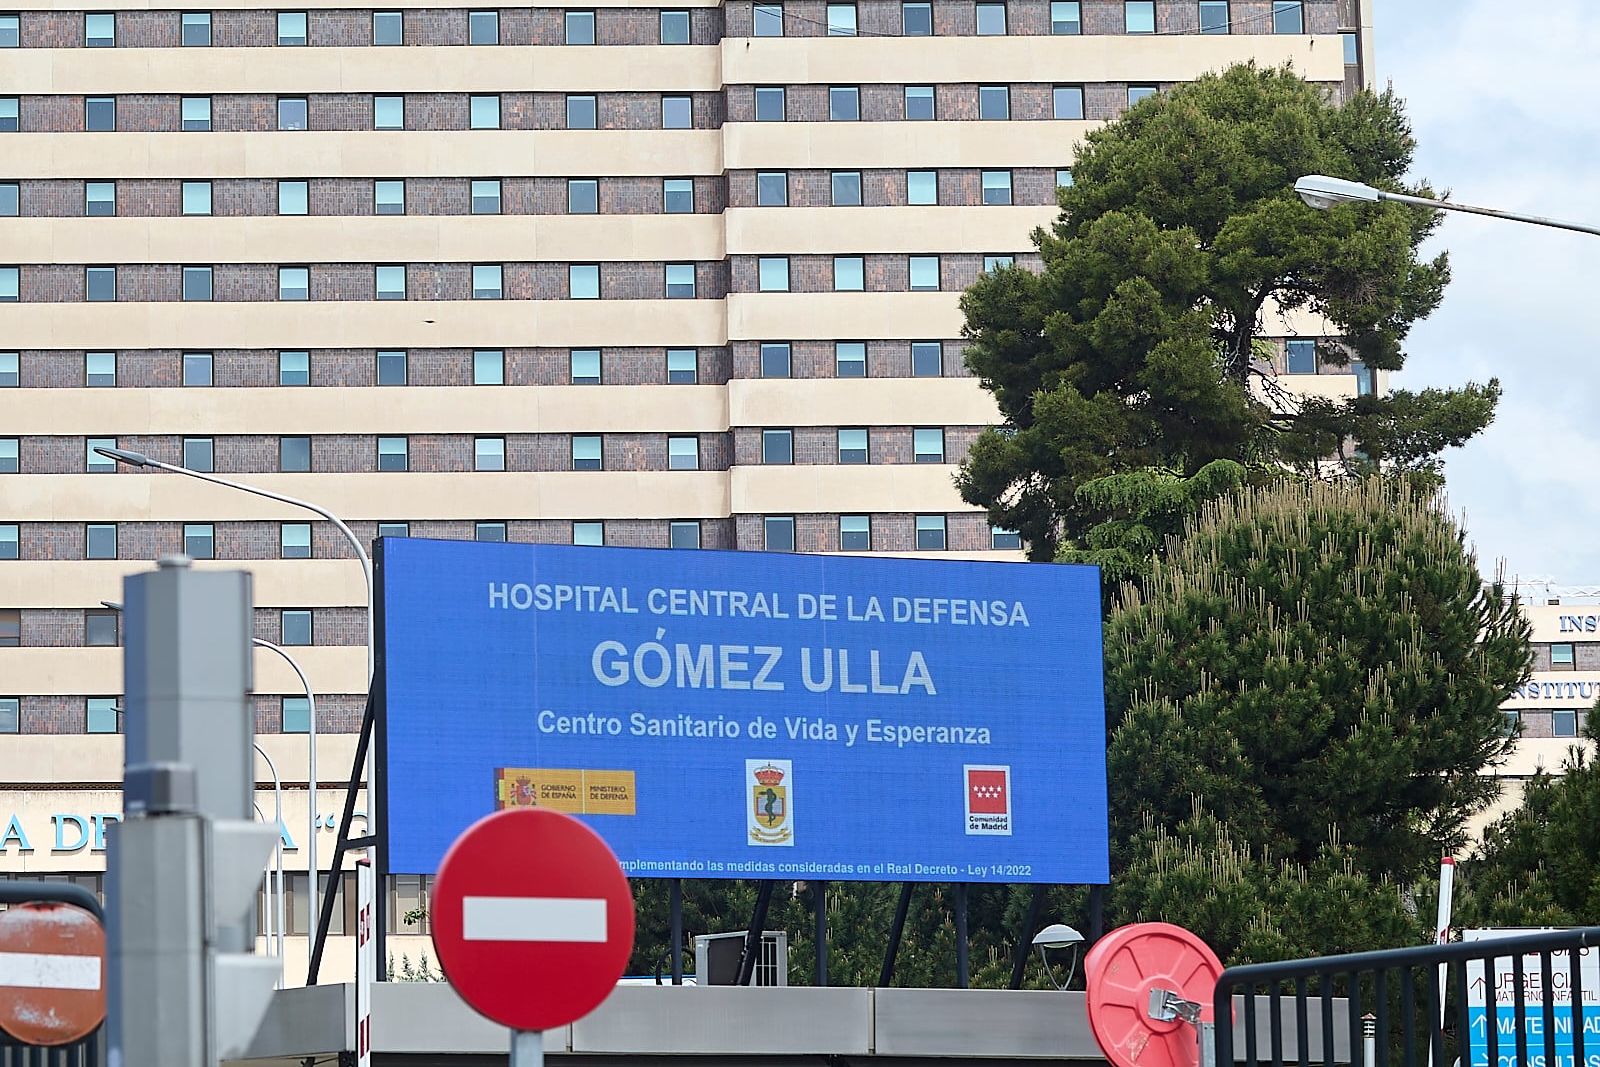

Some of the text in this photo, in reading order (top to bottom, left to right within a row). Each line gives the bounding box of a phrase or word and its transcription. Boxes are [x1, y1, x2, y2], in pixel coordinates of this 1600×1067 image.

[489, 582, 1030, 627] HOSPITAL CENTRAL DE LA DEFENSA
[1559, 615, 1600, 633] INS
[591, 627, 937, 695] GÓMEZ ULLA
[1511, 682, 1600, 700] NSTITU
[537, 710, 991, 748] Centro Sanitario de Vida y Esperanza
[551, 791, 577, 799] ESPAÑA
[969, 815, 1008, 823] Comunidad
[981, 823, 1008, 831] Madrid
[617, 859, 704, 872] mplementando
[706, 860, 725, 872] las
[726, 861, 776, 873] medidas
[777, 862, 854, 875] consideradas
[856, 865, 871, 874] en
[873, 863, 885, 875] el
[886, 863, 913, 875] Real
[914, 863, 959, 876] Decreto
[967, 864, 988, 878] Ley
[990, 865, 1032, 876] 14/2022
